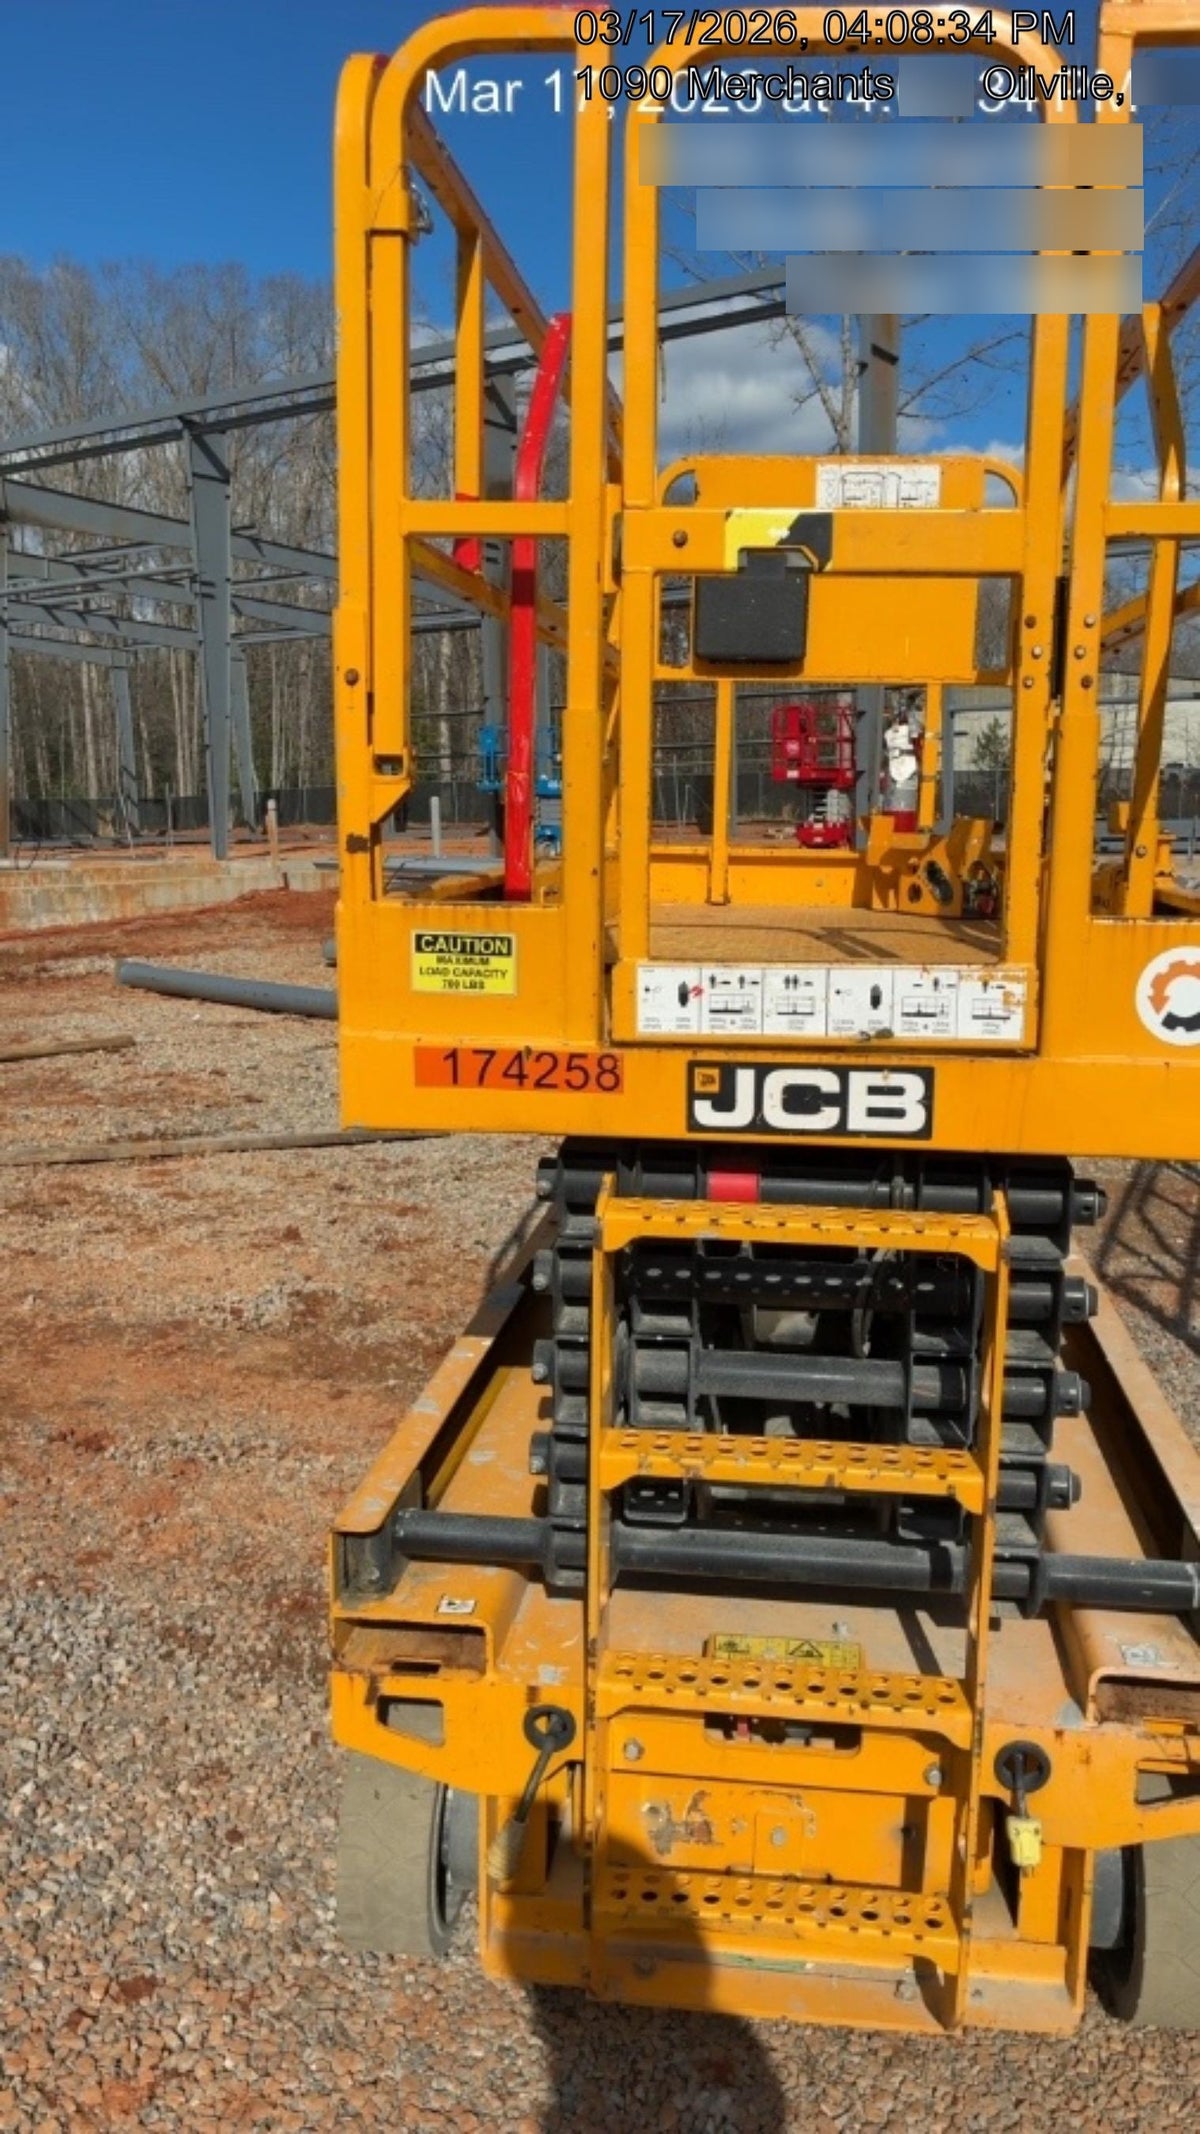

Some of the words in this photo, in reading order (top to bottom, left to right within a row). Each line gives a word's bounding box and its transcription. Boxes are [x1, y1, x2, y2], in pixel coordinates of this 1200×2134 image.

[421, 935, 509, 955] CAUTION
[419, 966, 451, 977] LOAD
[452, 967, 508, 979] CAPACITY
[443, 1047, 621, 1092] 174258
[693, 1067, 927, 1132] JCB
